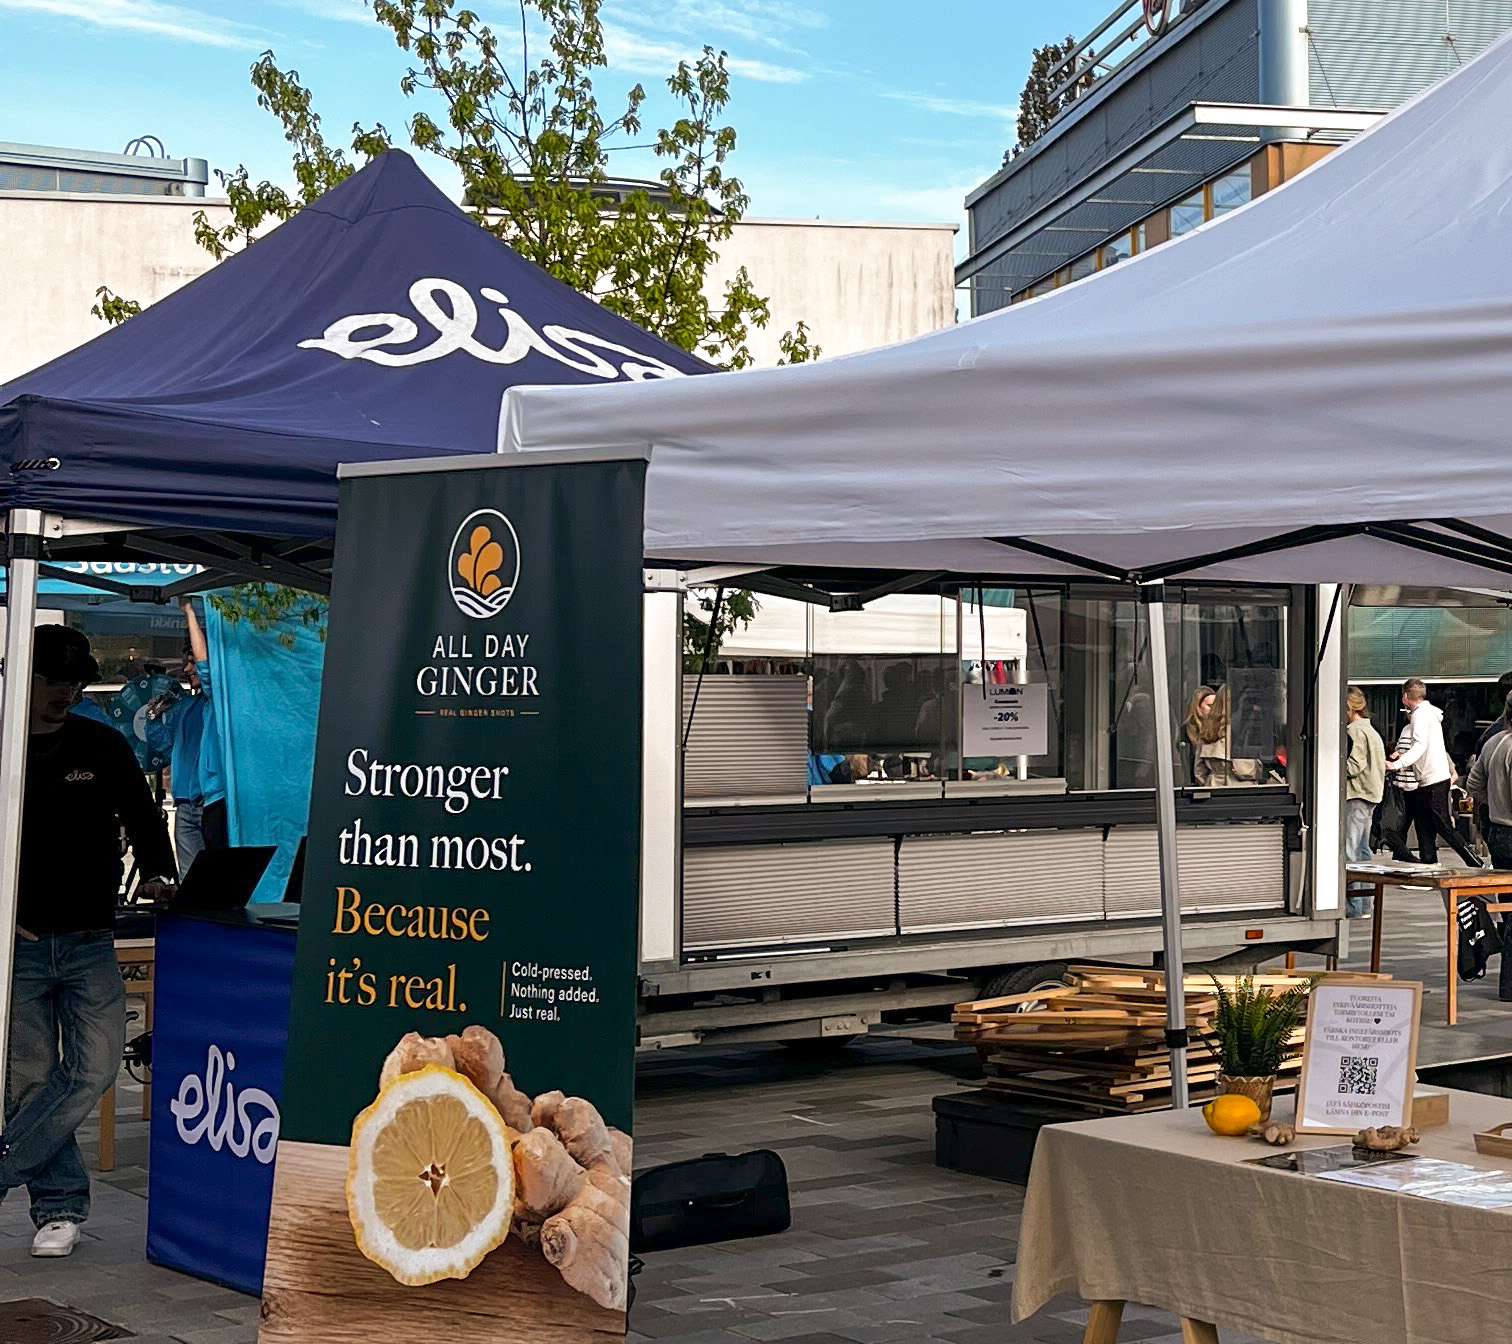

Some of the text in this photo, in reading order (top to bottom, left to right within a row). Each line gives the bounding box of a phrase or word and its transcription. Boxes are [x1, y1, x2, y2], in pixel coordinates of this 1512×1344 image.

[432, 634, 530, 659] ALL DAY
[416, 666, 540, 697] GINGER
[994, 712, 1019, 722] -20%
[344, 748, 509, 814] Stronger
[338, 818, 532, 872] than most.
[331, 886, 490, 941] Because
[324, 958, 467, 1012] it’s real.
[512, 961, 593, 982] Cold-pressed.
[511, 982, 600, 1004] Nothing added.
[509, 1004, 560, 1022] Just real.
[170, 1044, 280, 1164] elisa
